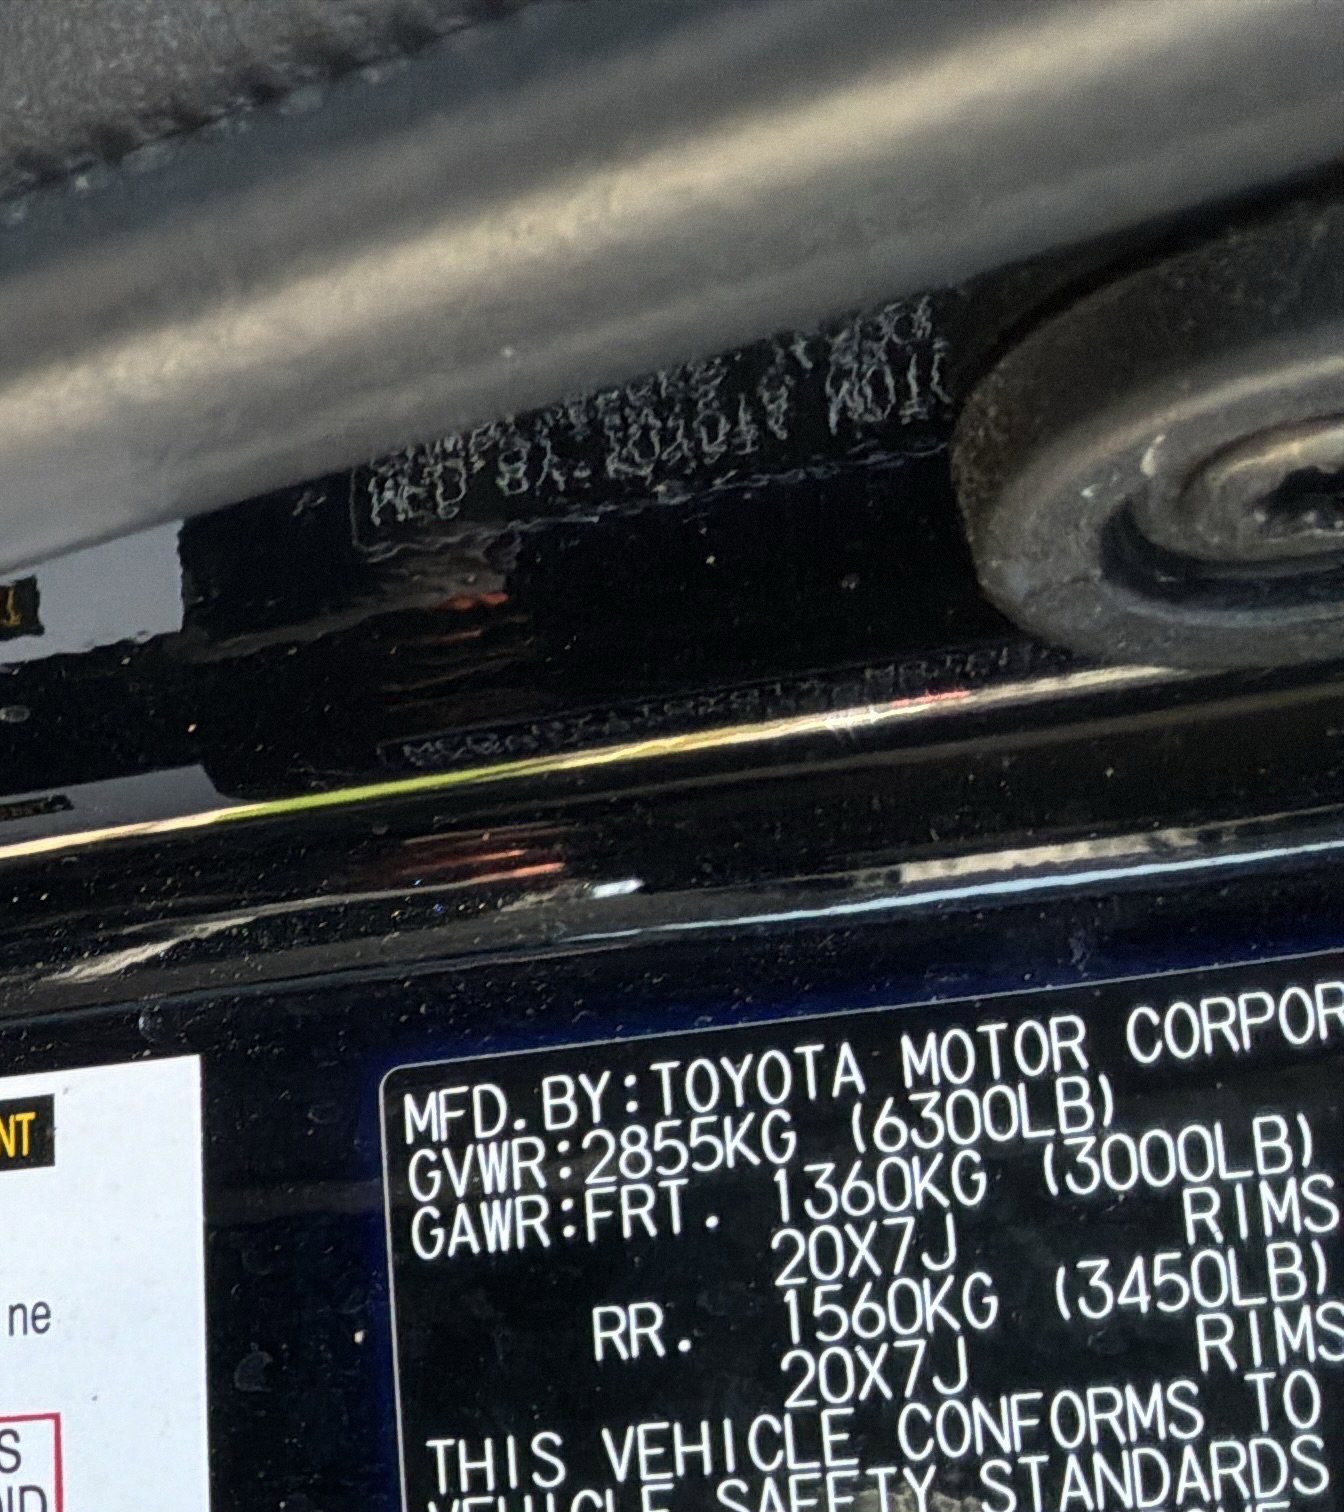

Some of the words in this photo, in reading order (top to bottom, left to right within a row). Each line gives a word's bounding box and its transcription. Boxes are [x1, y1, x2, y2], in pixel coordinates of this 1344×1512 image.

[900, 1014, 1089, 1089] MOTOR
[773, 1148, 987, 1223] 1360KG
[1043, 1113, 1313, 1196] (3000LB)
[851, 1073, 1114, 1154] (6300LB)
[771, 1212, 957, 1287] 20X7J
[1182, 1173, 1340, 1246] RIMS
[8, 1301, 51, 1337] ne
[592, 1301, 691, 1362] RR.
[783, 1271, 999, 1345] 1560KG
[1055, 1239, 1327, 1321] (3450LB)
[780, 1335, 968, 1409] 20X7J
[1195, 1300, 1344, 1373] RIMS
[425, 1431, 566, 1495] THIS
[601, 1407, 859, 1483] VEHICLE
[897, 1379, 1205, 1462] CONFORMS
[1243, 1368, 1321, 1433] TO
